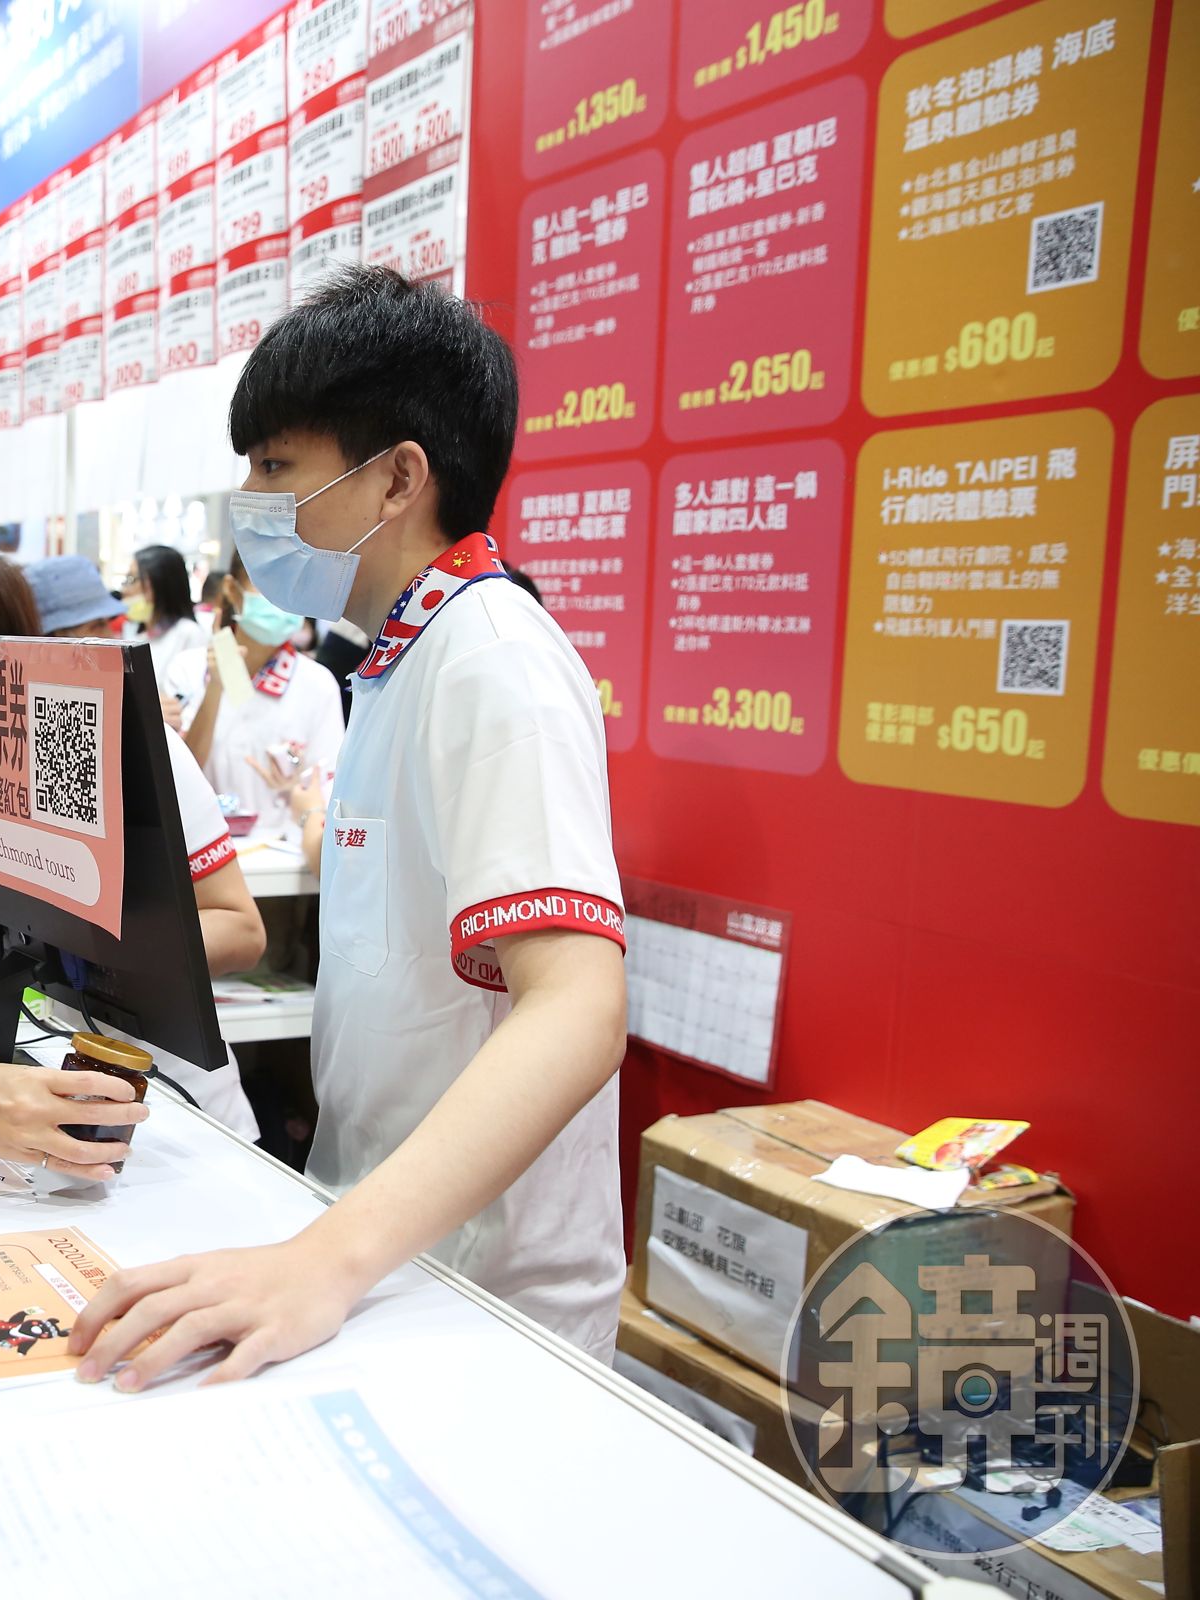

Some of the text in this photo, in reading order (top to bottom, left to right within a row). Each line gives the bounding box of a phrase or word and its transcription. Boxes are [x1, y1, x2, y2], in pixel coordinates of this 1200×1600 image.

[905, 18, 1116, 119] 秋冬泡湯樂 海底
[903, 82, 1040, 153] 溫泉體驗券
[882, 448, 1078, 490] i-Ride TAIPEI 飛
[674, 476, 751, 509] 多人派對
[880, 486, 1037, 525] 行劇院體驗票
[1161, 474, 1200, 510] 門
[45, 853, 76, 882] tours
[460, 896, 623, 939] RICHMOND TOURS
